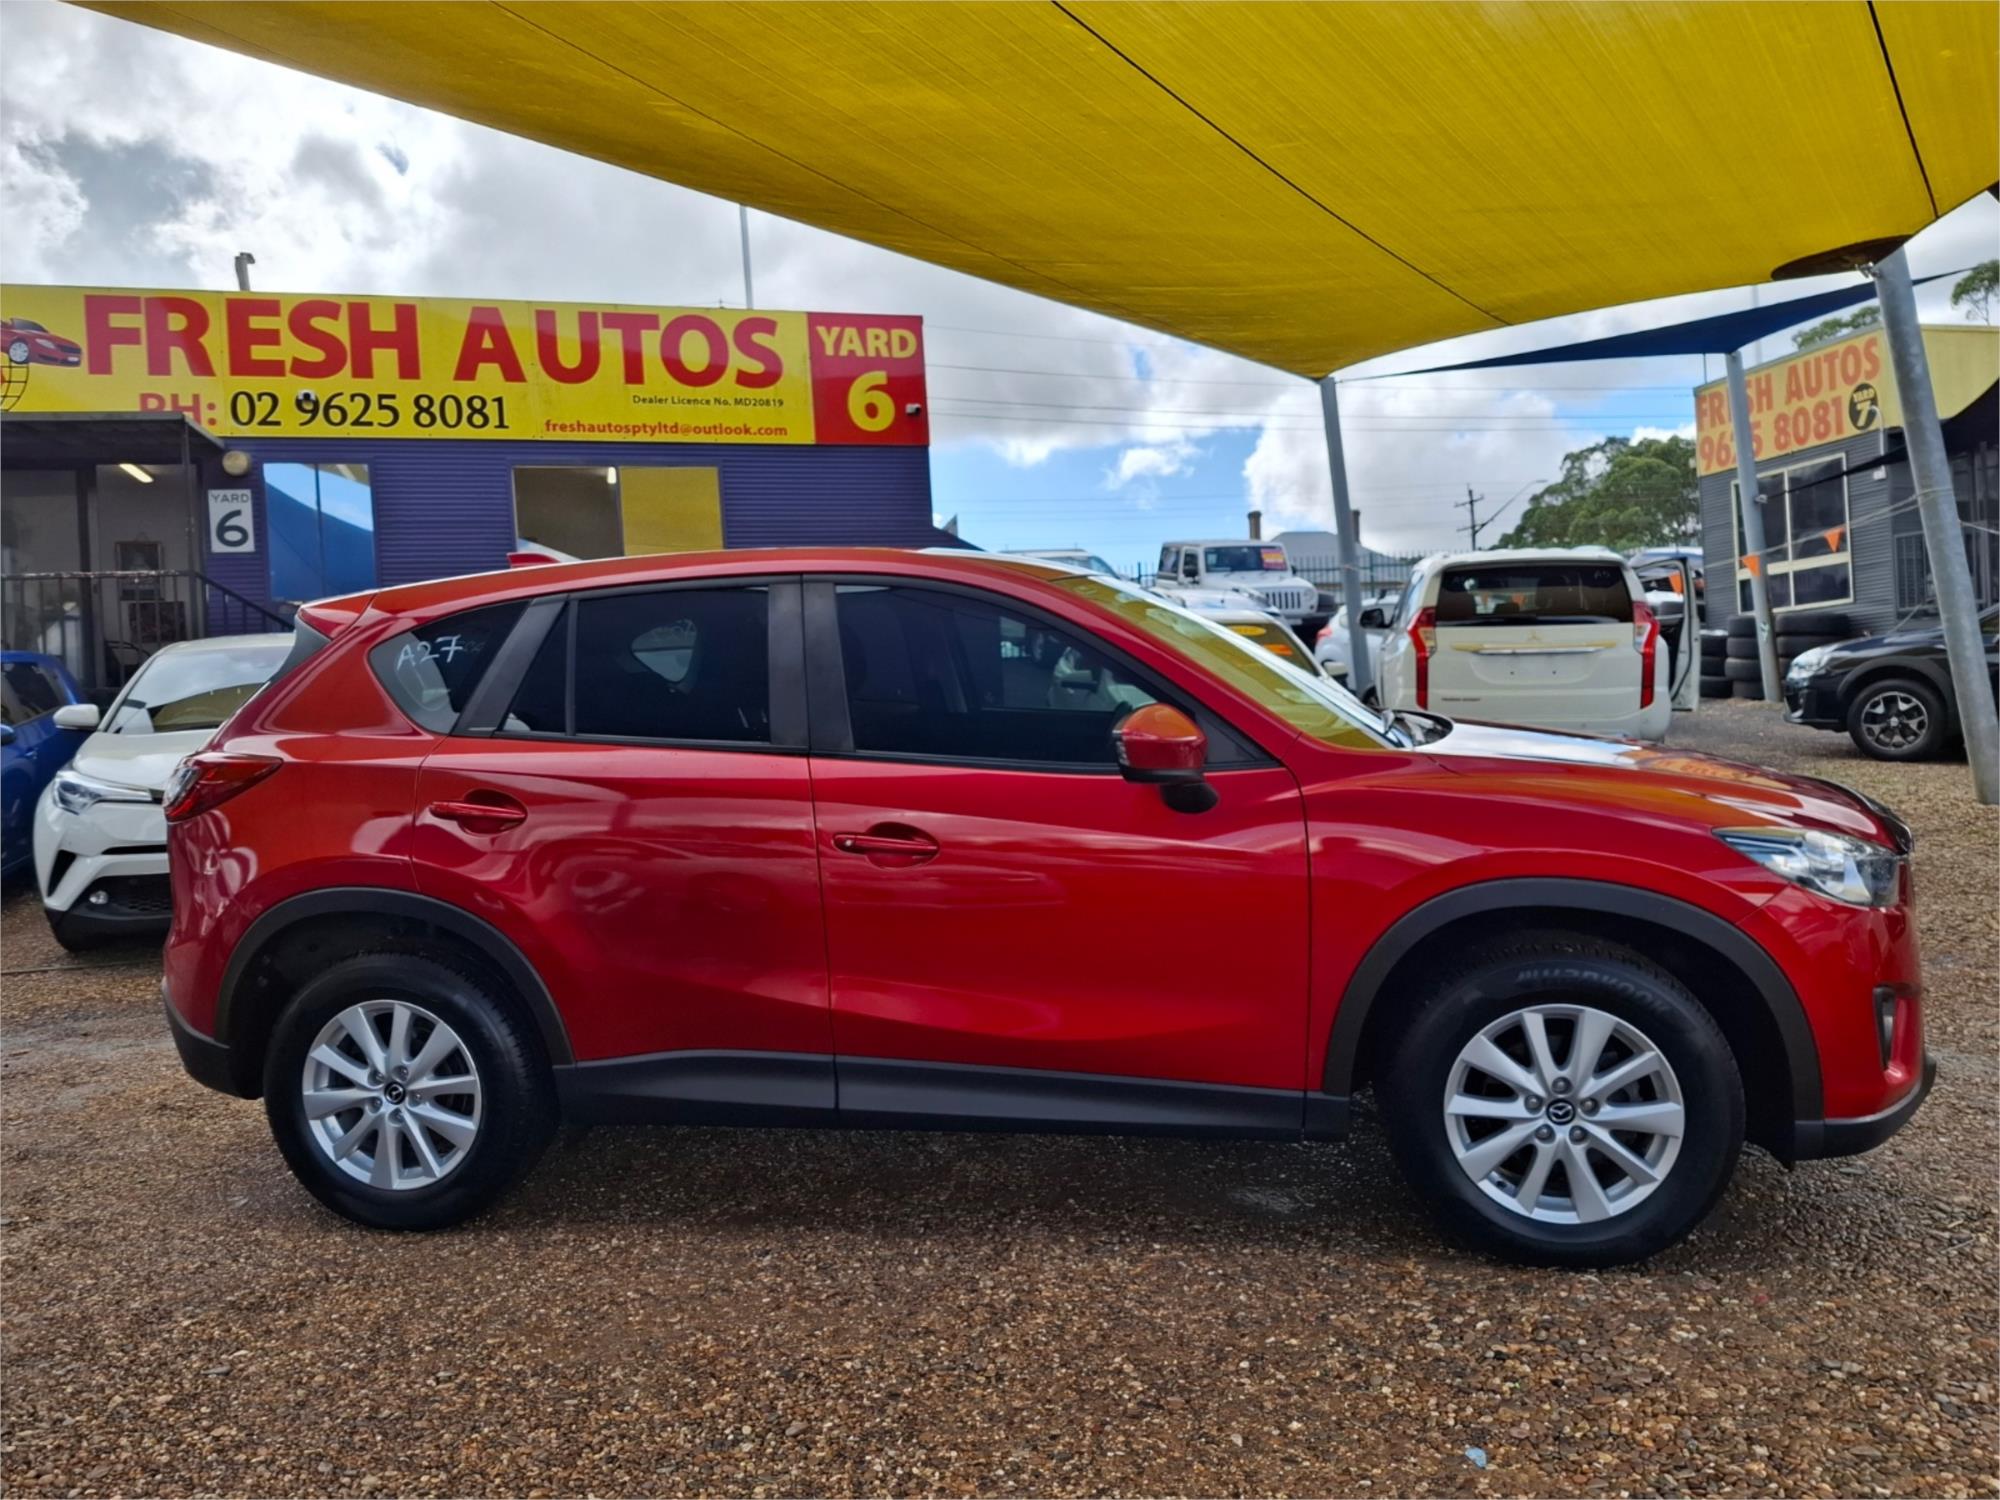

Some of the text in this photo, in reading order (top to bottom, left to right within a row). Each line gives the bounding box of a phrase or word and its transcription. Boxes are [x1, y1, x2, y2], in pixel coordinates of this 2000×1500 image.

[84, 294, 784, 389] FRESH AUTOS
[816, 326, 917, 358] YARD
[632, 395, 784, 408] Dealer Licence No. MD20819
[847, 371, 896, 432] 6
[1696, 336, 1881, 432] FRSH AUTOS
[231, 391, 281, 426] 02
[295, 391, 400, 427] 9625
[413, 394, 509, 430] 8081
[545, 420, 788, 438] freshautosptyltd@outlook.com
[1856, 400, 1872, 427] 7
[1701, 396, 1844, 472] 965 8081
[211, 493, 249, 504] YARD
[215, 509, 249, 547] 6
[396, 634, 463, 671] A27
